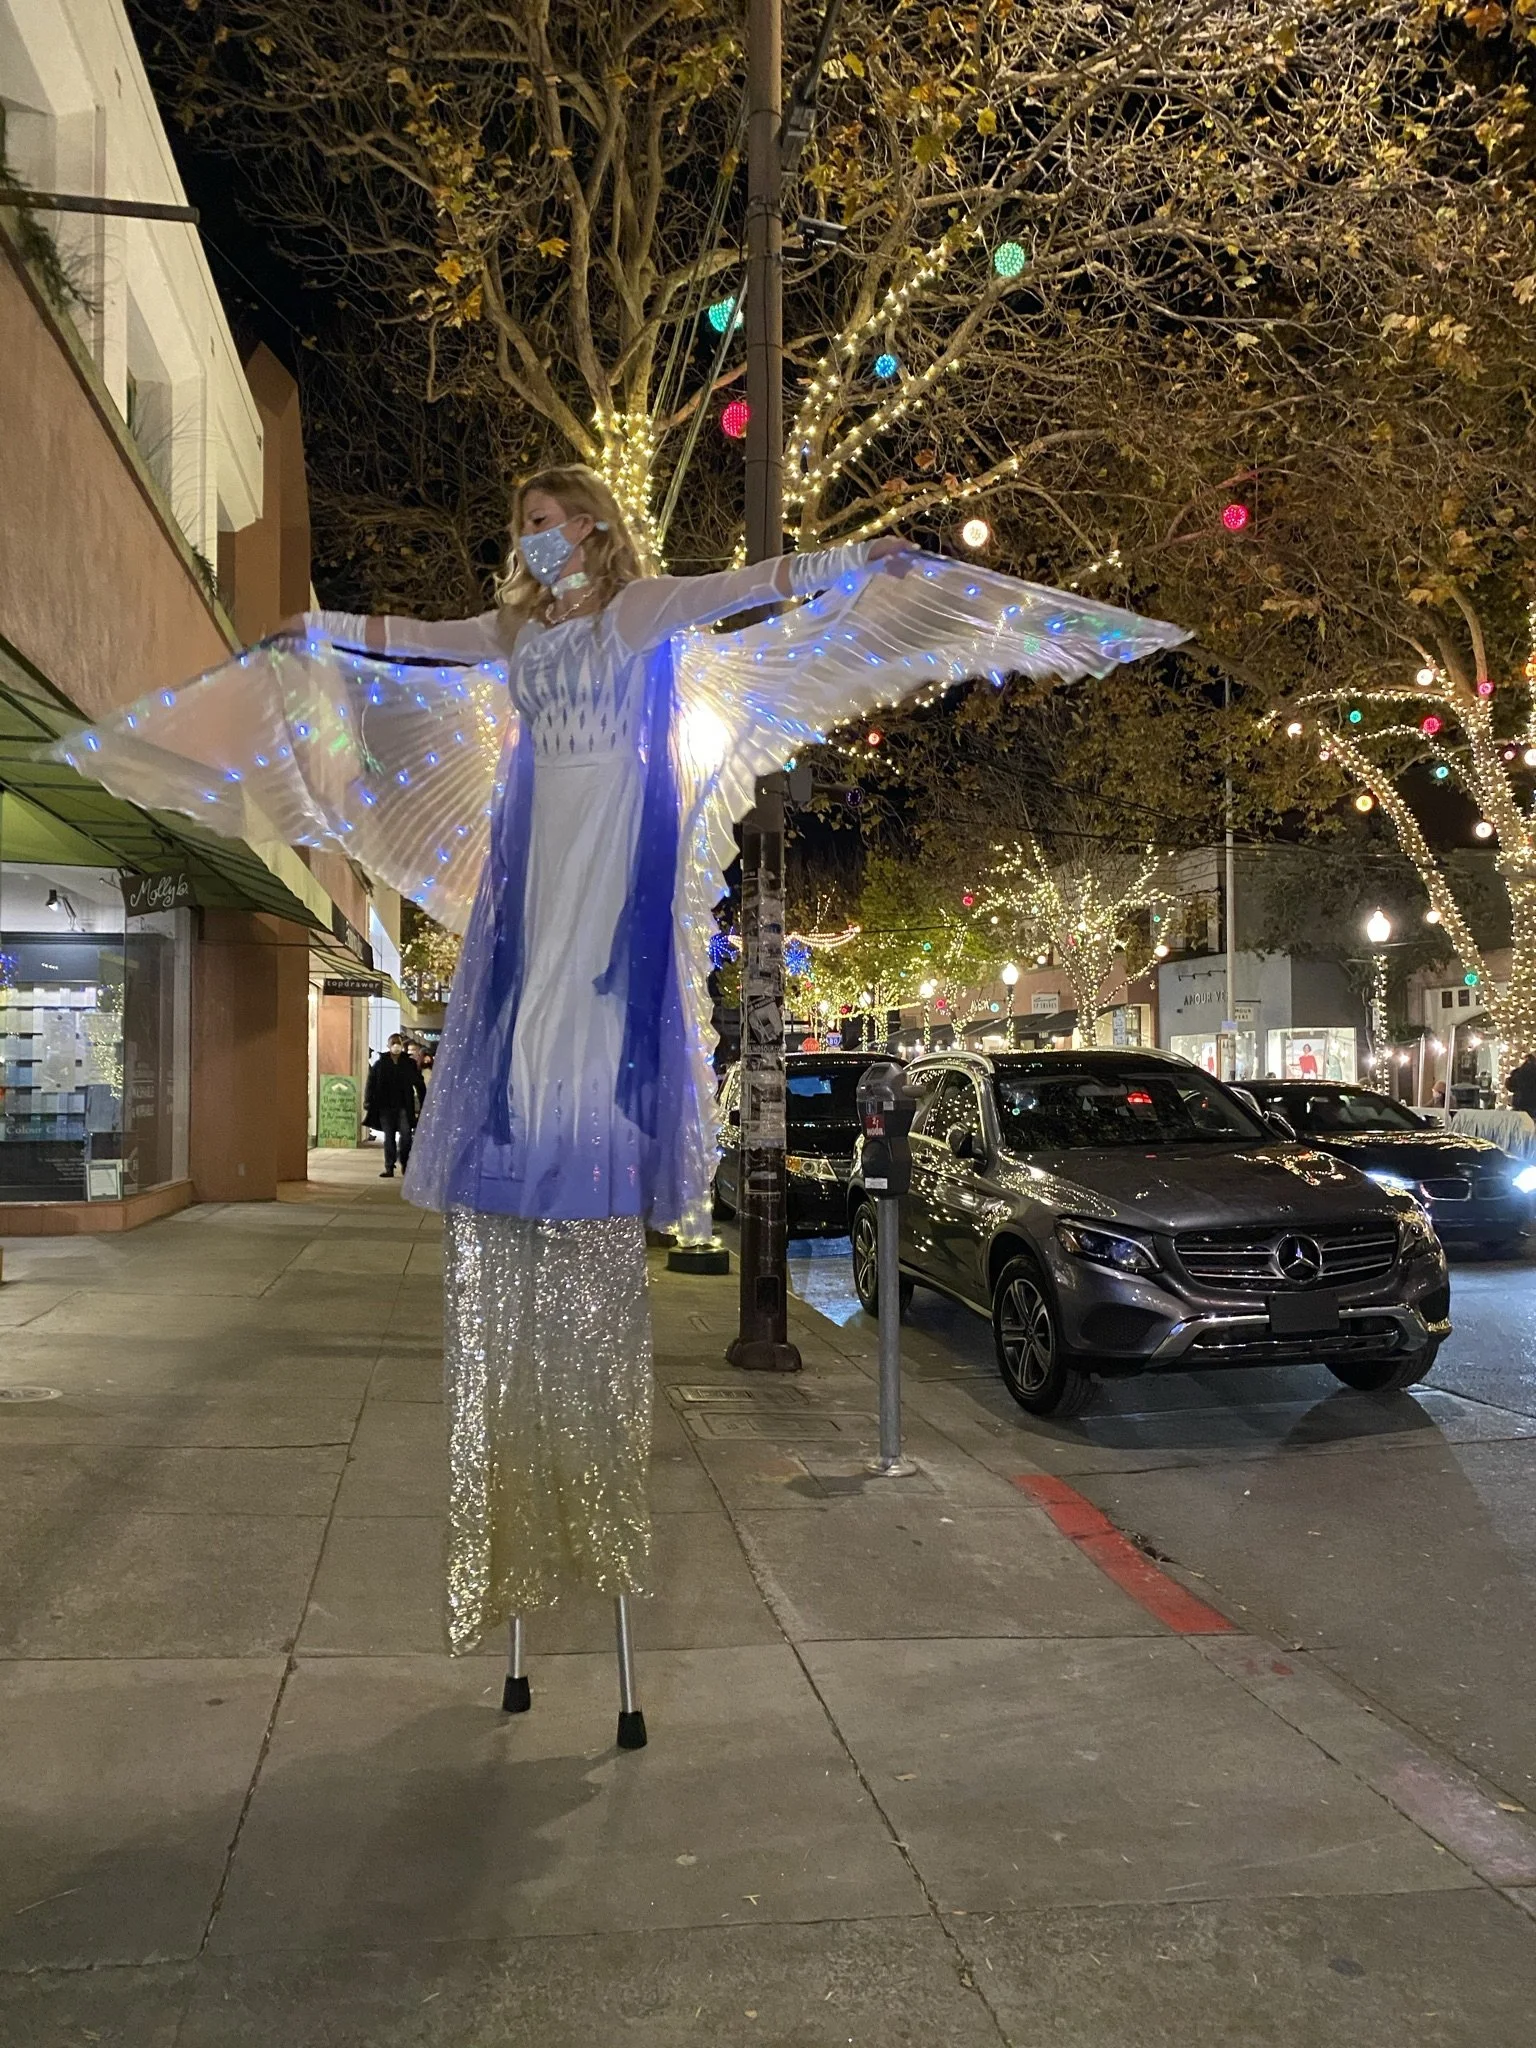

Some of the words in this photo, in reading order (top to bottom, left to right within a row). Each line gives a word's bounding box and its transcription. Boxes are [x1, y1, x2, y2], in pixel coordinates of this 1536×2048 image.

[326, 980, 379, 989] topdrawer
[1184, 992, 1213, 1006] AMOUR
[804, 1041, 818, 1049] STOP
